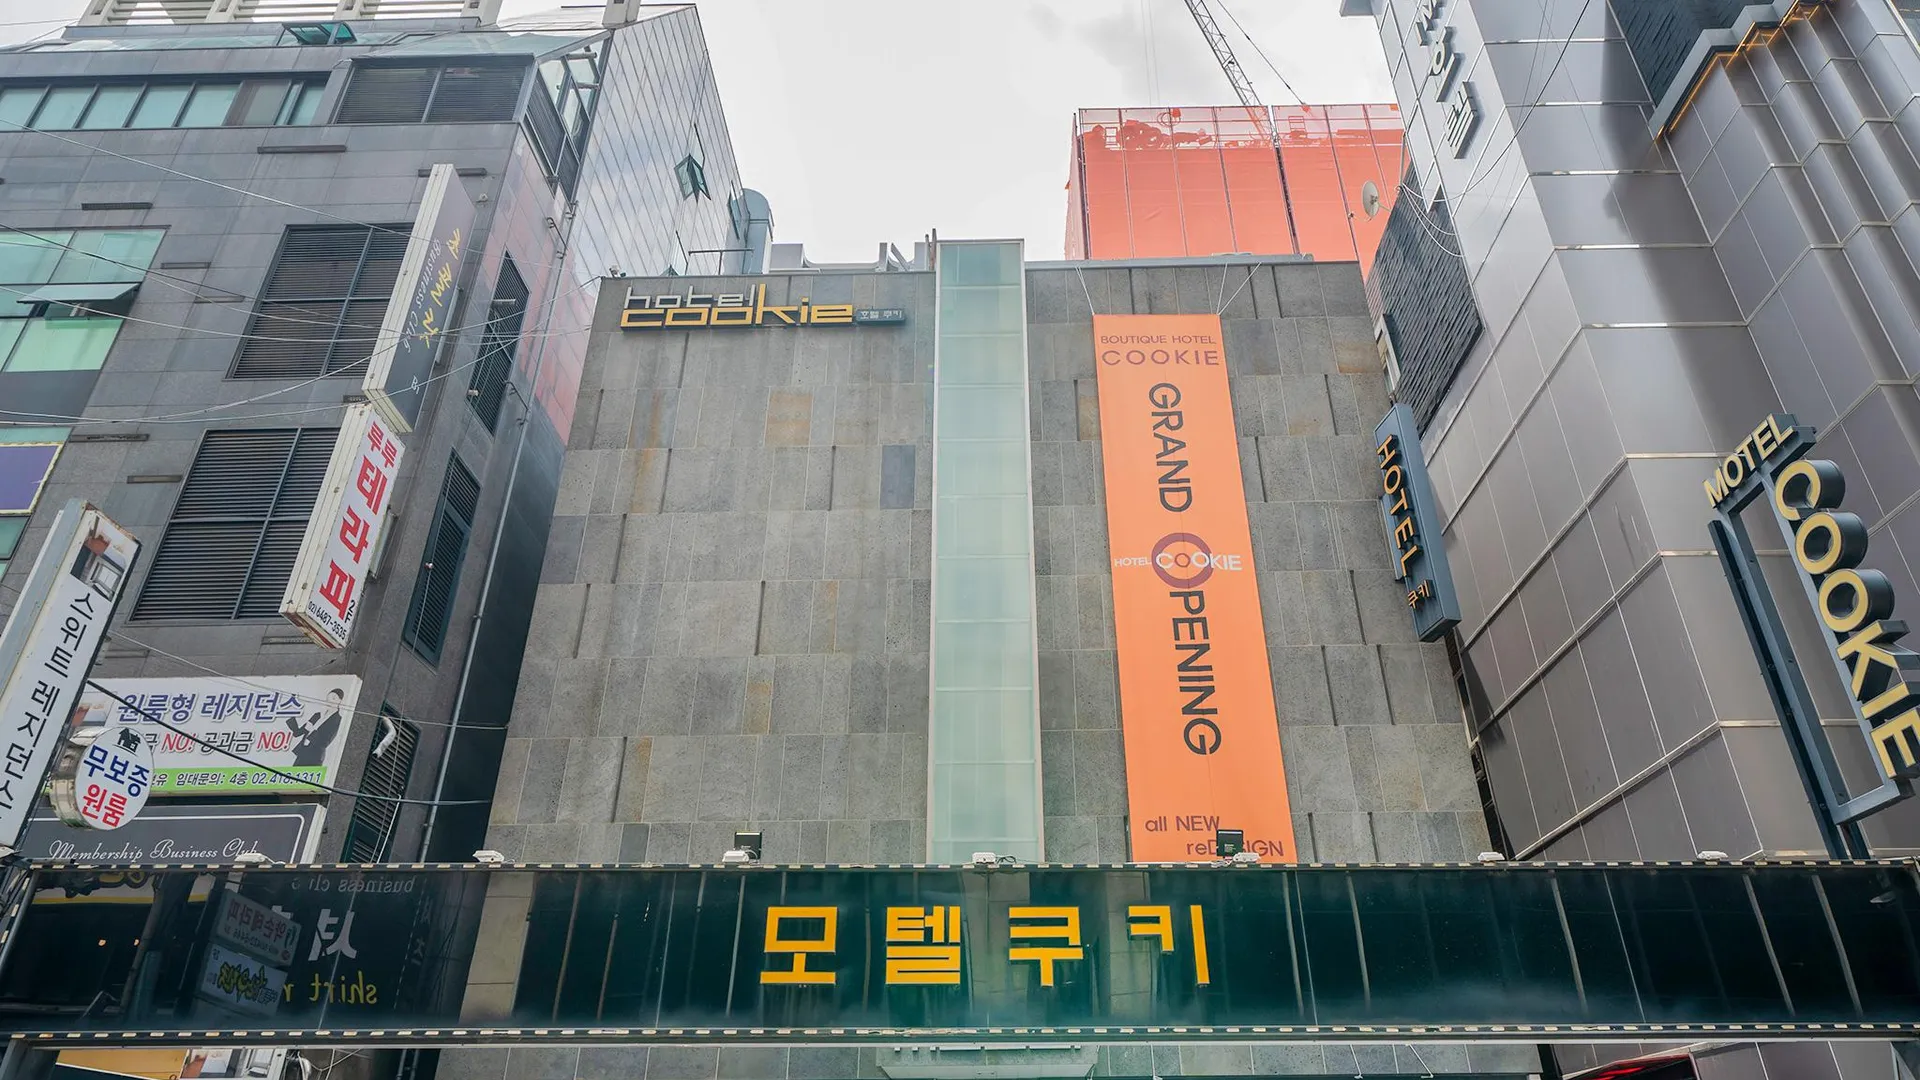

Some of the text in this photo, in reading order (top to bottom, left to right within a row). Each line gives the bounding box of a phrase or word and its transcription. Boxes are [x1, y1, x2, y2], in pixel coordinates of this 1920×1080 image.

[415, 238, 442, 309] Business
[620, 283, 853, 327] cookie
[624, 284, 756, 309] hotel
[1100, 335, 1216, 345] BOUTIQUE HOTEL
[1101, 349, 1220, 366] COOKIE
[1149, 382, 1193, 513] GRAND
[1702, 413, 1794, 508] MOTEL
[1376, 434, 1418, 578] HOTEL
[319, 455, 388, 621] 테라피
[1114, 552, 1243, 571] HOTEL COOKIE
[1407, 580, 1431, 610] 쿠키
[45, 592, 94, 679] 스위트
[1775, 459, 1920, 779] COOKIE
[117, 692, 302, 723] 원룸형 레지던스
[161, 732, 195, 752] NO!
[200, 732, 253, 753] 공과금
[257, 731, 292, 751] NO!
[83, 744, 149, 797] 무보증
[176, 773, 226, 786] 임대문의:
[229, 772, 248, 786] 4층
[81, 783, 128, 829] 원룸
[1145, 815, 1220, 832] all NEW
[49, 840, 143, 863] Membership
[150, 838, 218, 859] Business
[1186, 840, 1285, 858] reDIGN
[759, 904, 1210, 987] 모텔쿠키
